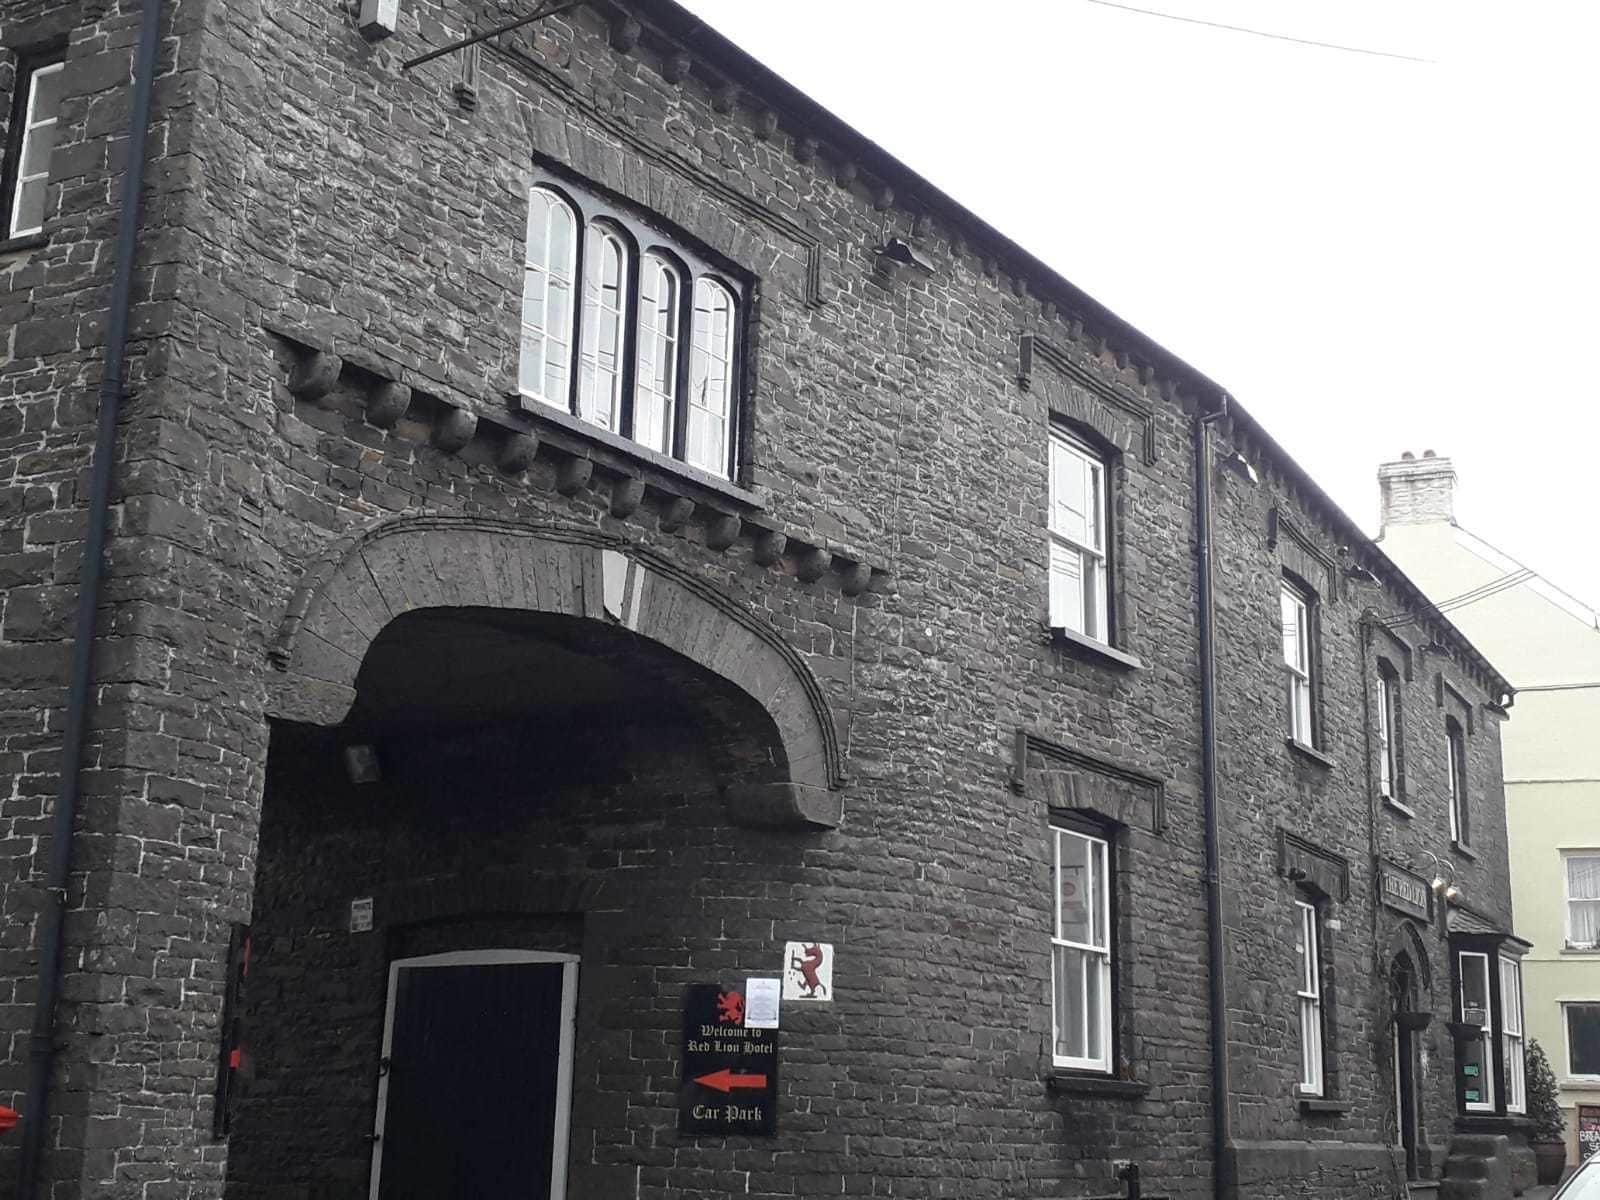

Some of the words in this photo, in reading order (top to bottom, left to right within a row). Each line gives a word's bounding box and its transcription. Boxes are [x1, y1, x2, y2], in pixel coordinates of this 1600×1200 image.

[701, 1024, 749, 1037] Welcome
[751, 1027, 762, 1037] to
[688, 1040, 710, 1052] Red
[714, 1040, 740, 1053] Lion
[743, 1041, 773, 1055] Hotel
[692, 1104, 720, 1120] Car
[725, 1104, 762, 1123] Park
